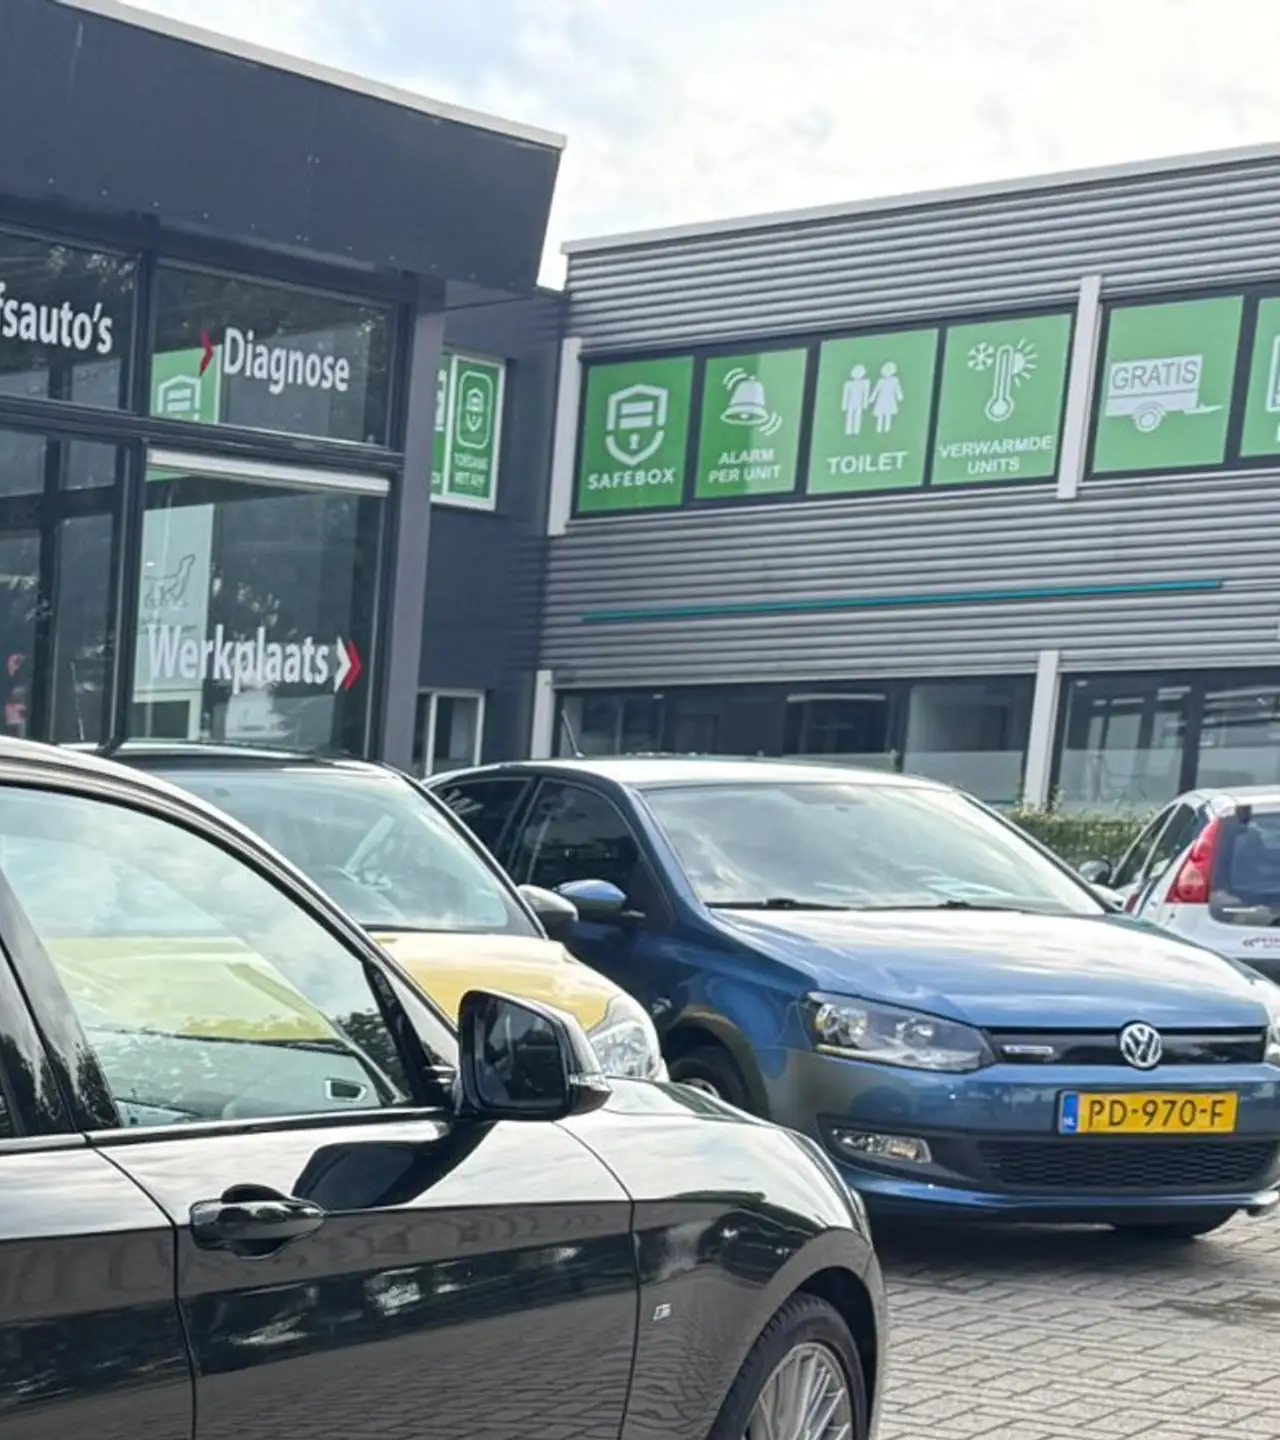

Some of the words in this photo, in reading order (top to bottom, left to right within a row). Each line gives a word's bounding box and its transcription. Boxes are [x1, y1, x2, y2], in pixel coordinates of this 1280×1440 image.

[223, 326, 350, 396] Diagnose
[1111, 360, 1199, 391] GRATIS
[718, 448, 775, 466] ALARM
[940, 435, 1053, 459] VERWARMDE
[707, 467, 740, 484] PER
[743, 464, 781, 481] UNIT
[827, 451, 909, 475] TOILET
[967, 456, 1020, 475] UNITS
[587, 468, 676, 490] SAFEBOX
[145, 623, 330, 695] Werkplaats
[1089, 1099, 1227, 1128] PD-970-F
